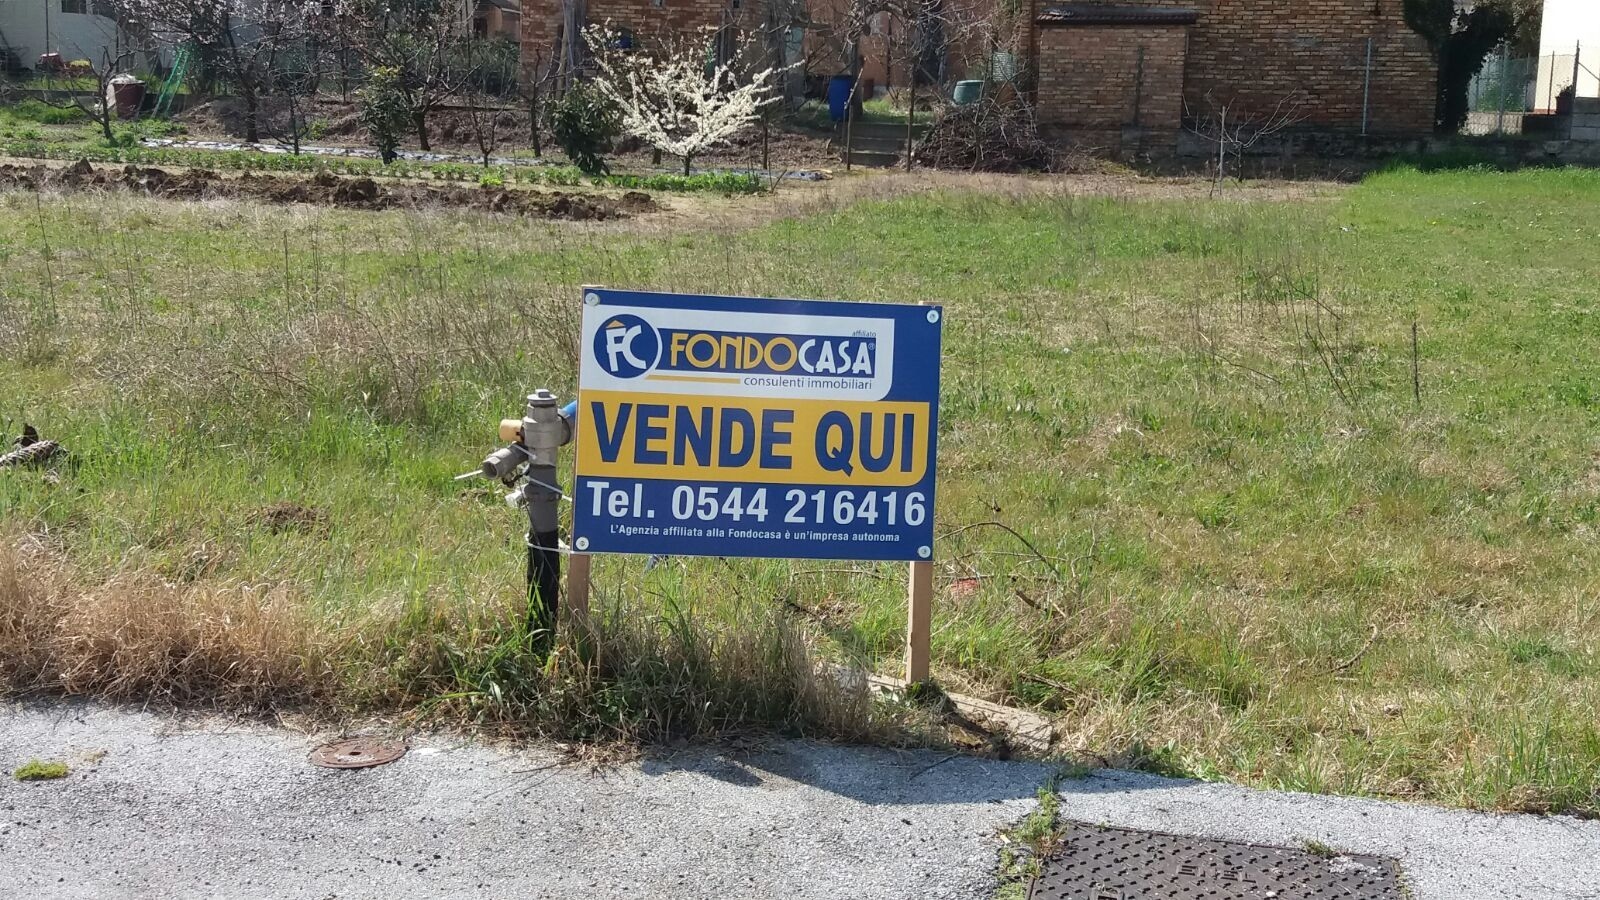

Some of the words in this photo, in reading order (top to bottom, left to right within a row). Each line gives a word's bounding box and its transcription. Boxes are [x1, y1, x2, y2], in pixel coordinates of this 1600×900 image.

[605, 324, 647, 372] FC
[670, 332, 872, 375] FONDOCASA
[851, 330, 877, 338] affiliato
[743, 375, 805, 388] consulenti
[807, 378, 872, 390] immobiliari
[590, 401, 795, 470] VENDE
[814, 410, 915, 478] QUI
[586, 480, 655, 519] Tel.
[671, 485, 769, 522] 0544
[784, 488, 926, 526] 216416
[610, 524, 660, 536] L'Agenzia
[662, 526, 703, 537] affiliata
[705, 527, 725, 537] alla
[728, 528, 782, 539] Fondocasa
[784, 529, 791, 540] è
[793, 530, 849, 542] un'impresa
[852, 533, 900, 542] autonoma
